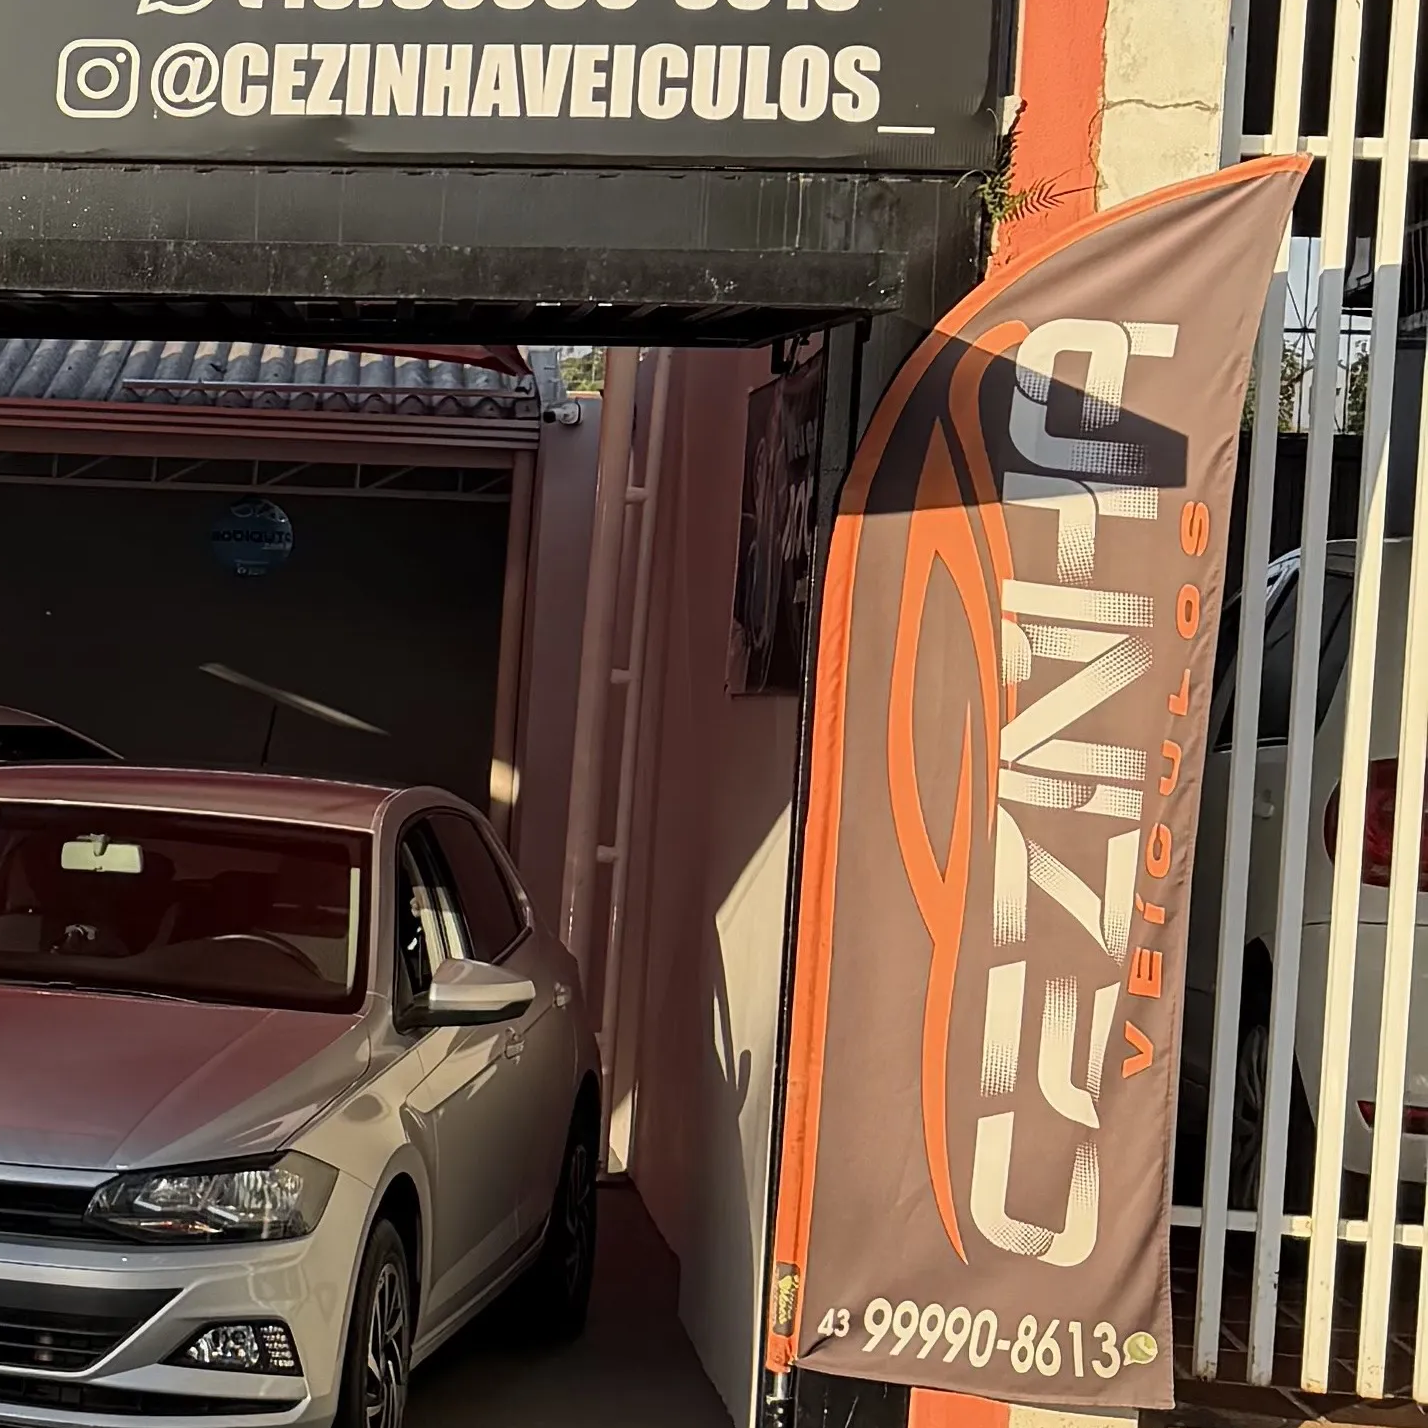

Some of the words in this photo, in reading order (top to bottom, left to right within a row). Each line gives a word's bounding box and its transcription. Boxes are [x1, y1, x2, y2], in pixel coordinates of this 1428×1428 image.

[970, 318, 1180, 1268] CEZINHA
[1122, 499, 1210, 1080] VEÍCULOS
[816, 1308, 852, 1339] 43
[861, 1297, 1125, 1380] 99990-8613
